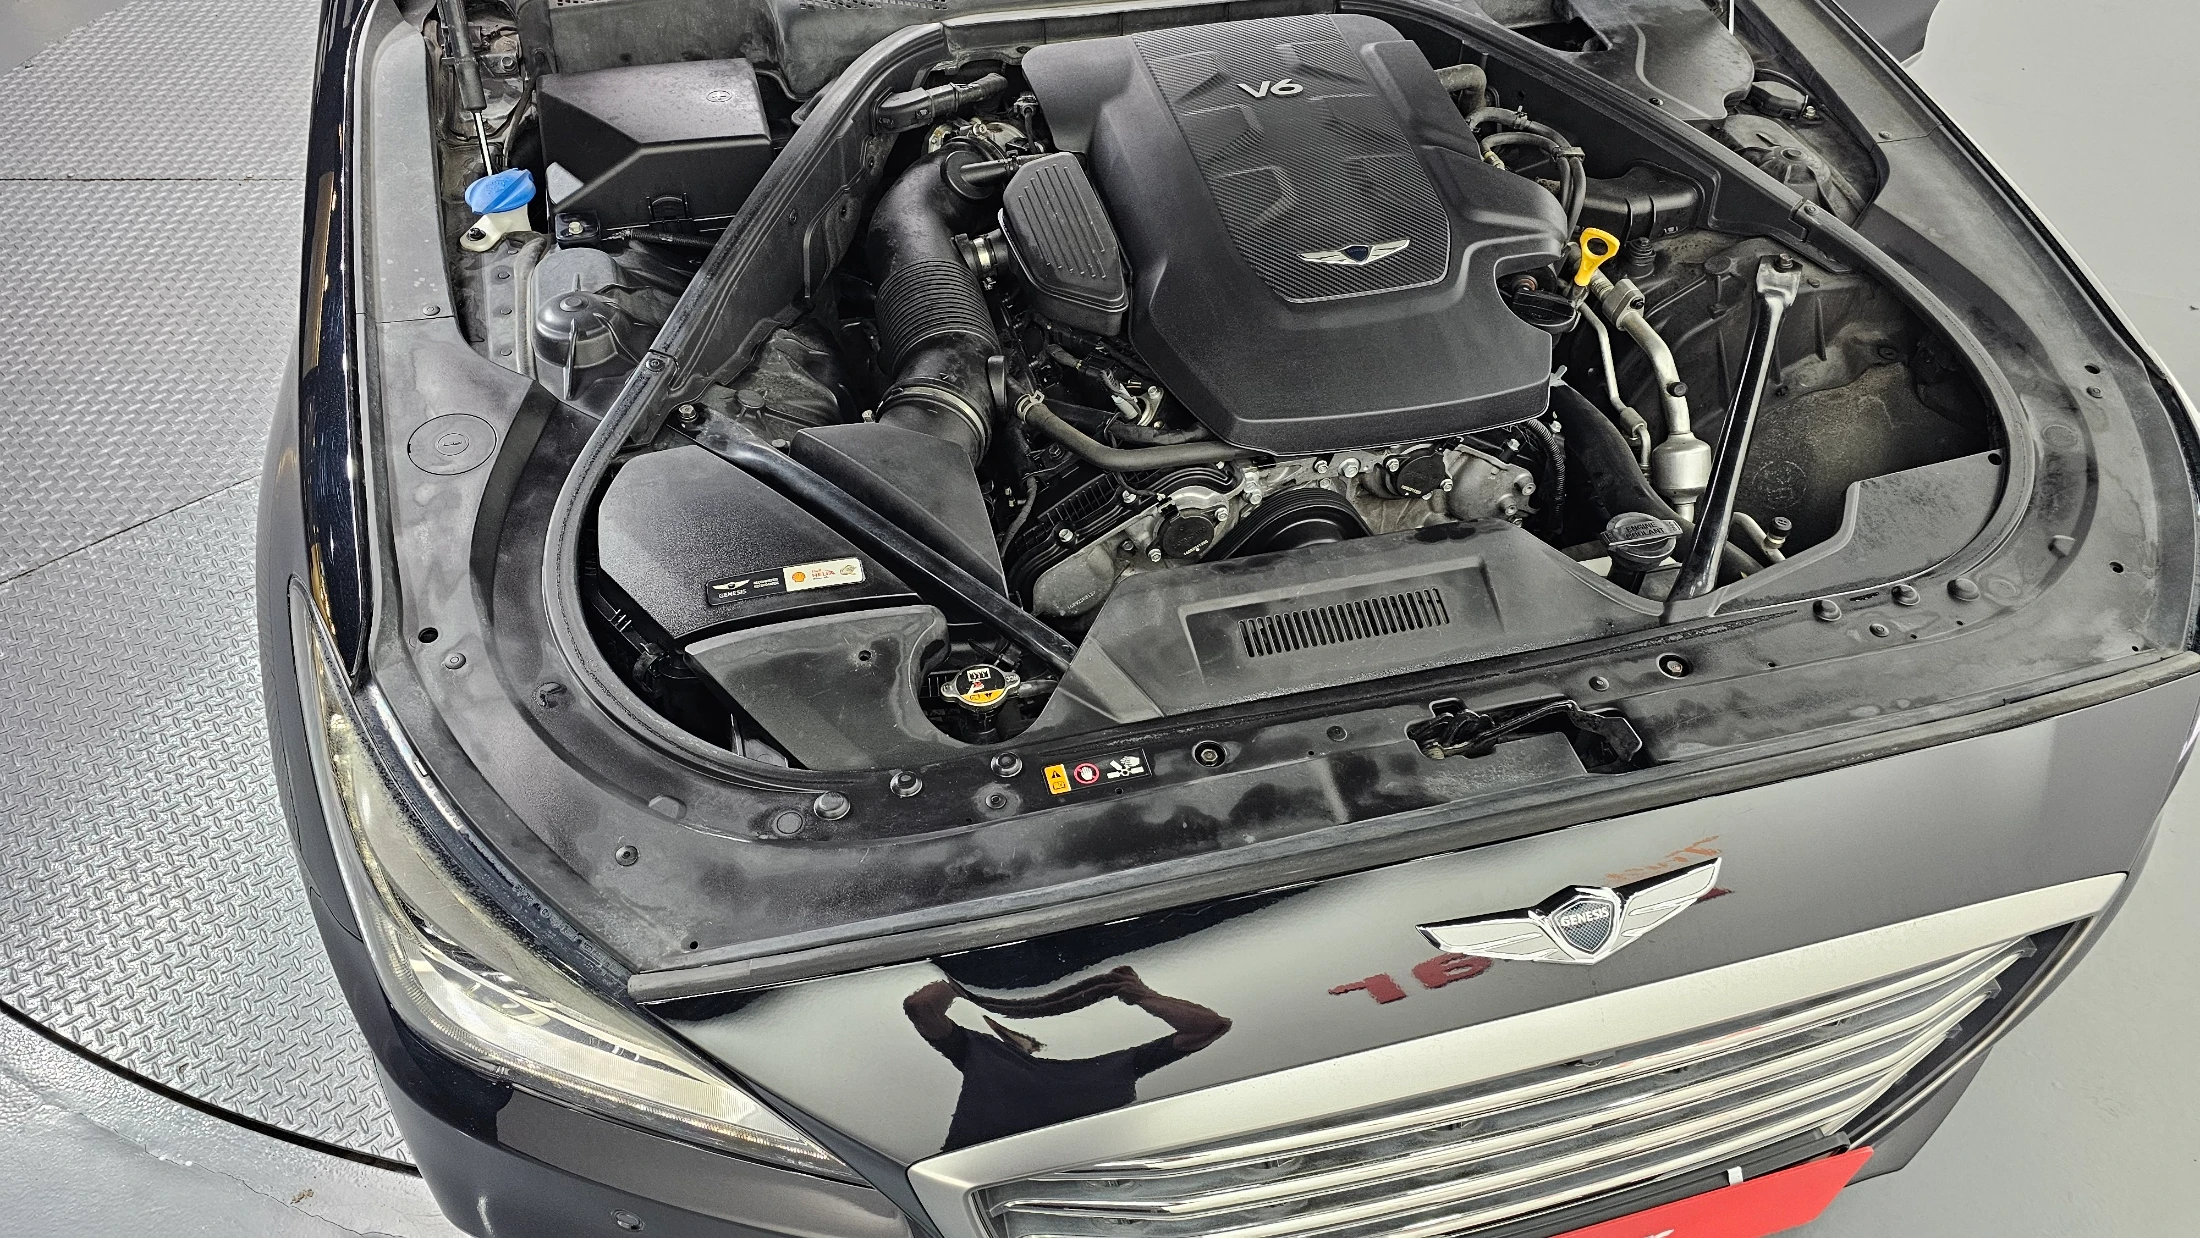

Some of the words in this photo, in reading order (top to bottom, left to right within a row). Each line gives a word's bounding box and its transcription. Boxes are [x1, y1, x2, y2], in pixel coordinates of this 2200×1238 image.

[1237, 79, 1303, 98] V6
[1625, 522, 1657, 532] ENGINE
[1624, 528, 1665, 539] COOLANT
[718, 589, 747, 599] GENESIS
[1561, 907, 1609, 927] GENESIS
